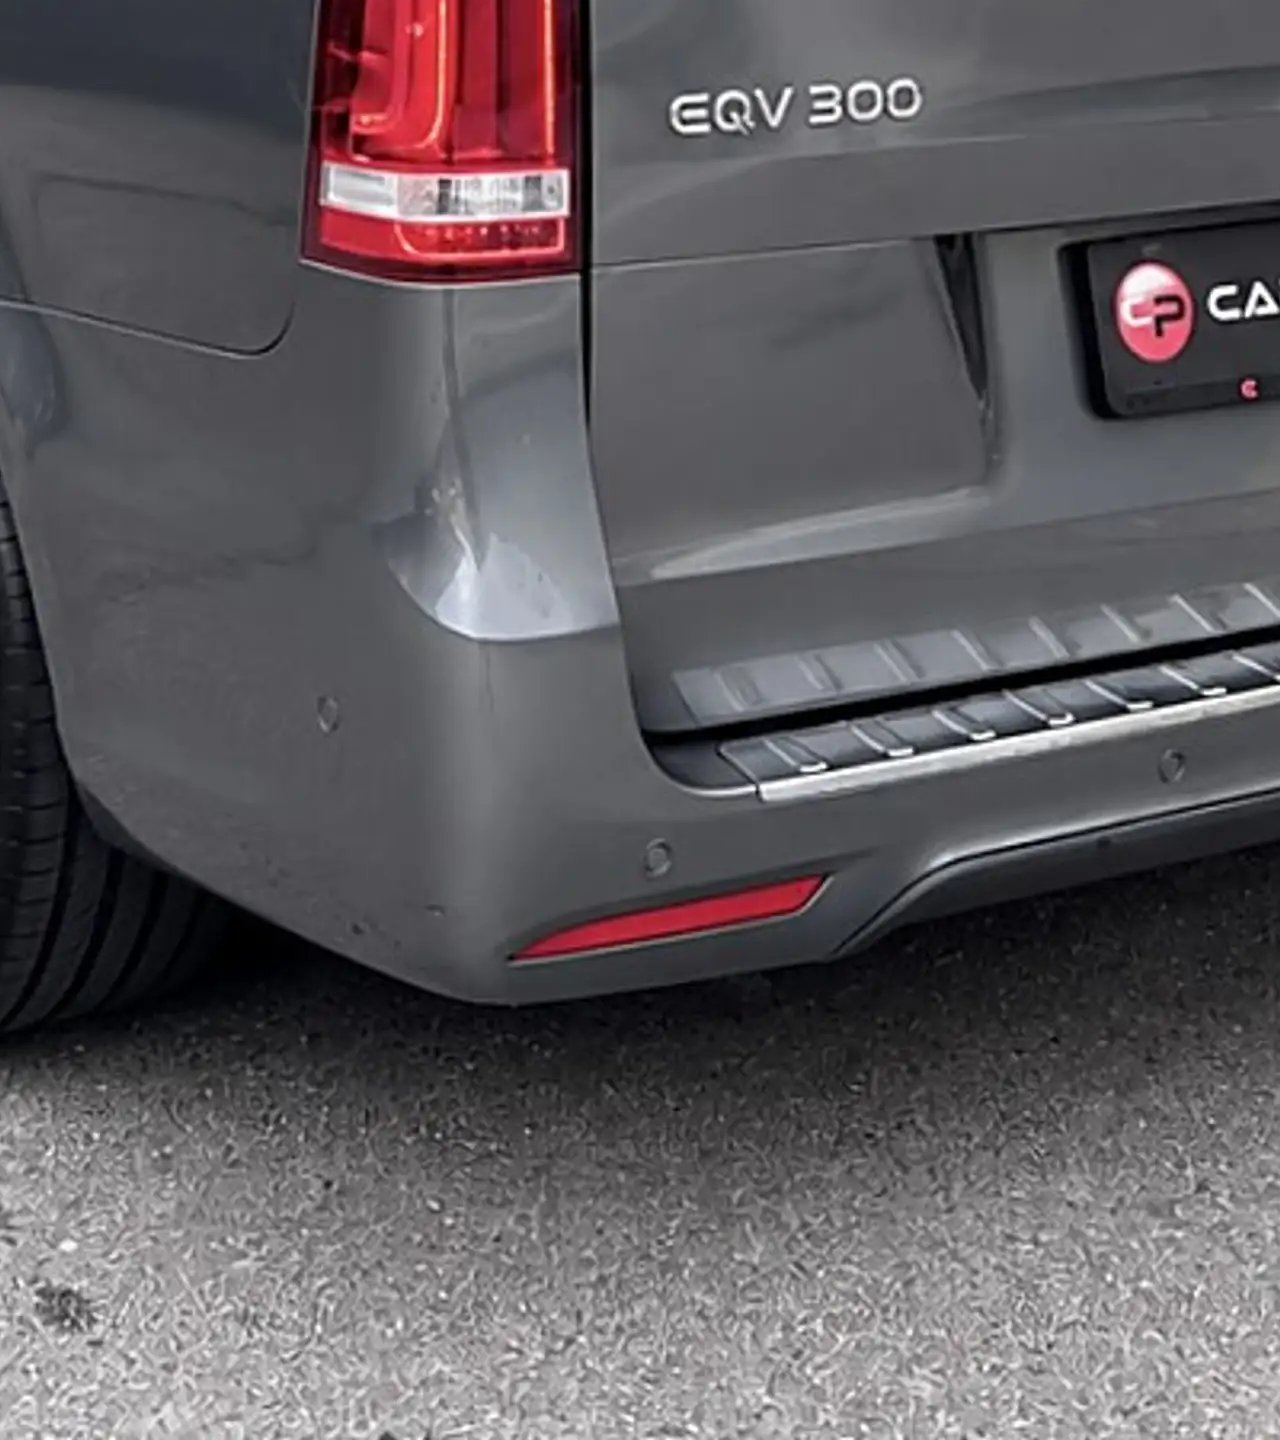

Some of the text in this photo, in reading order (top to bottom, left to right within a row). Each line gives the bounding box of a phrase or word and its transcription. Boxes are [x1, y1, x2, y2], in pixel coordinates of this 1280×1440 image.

[670, 78, 923, 135] EQV 300
[1120, 294, 1185, 338] CP
